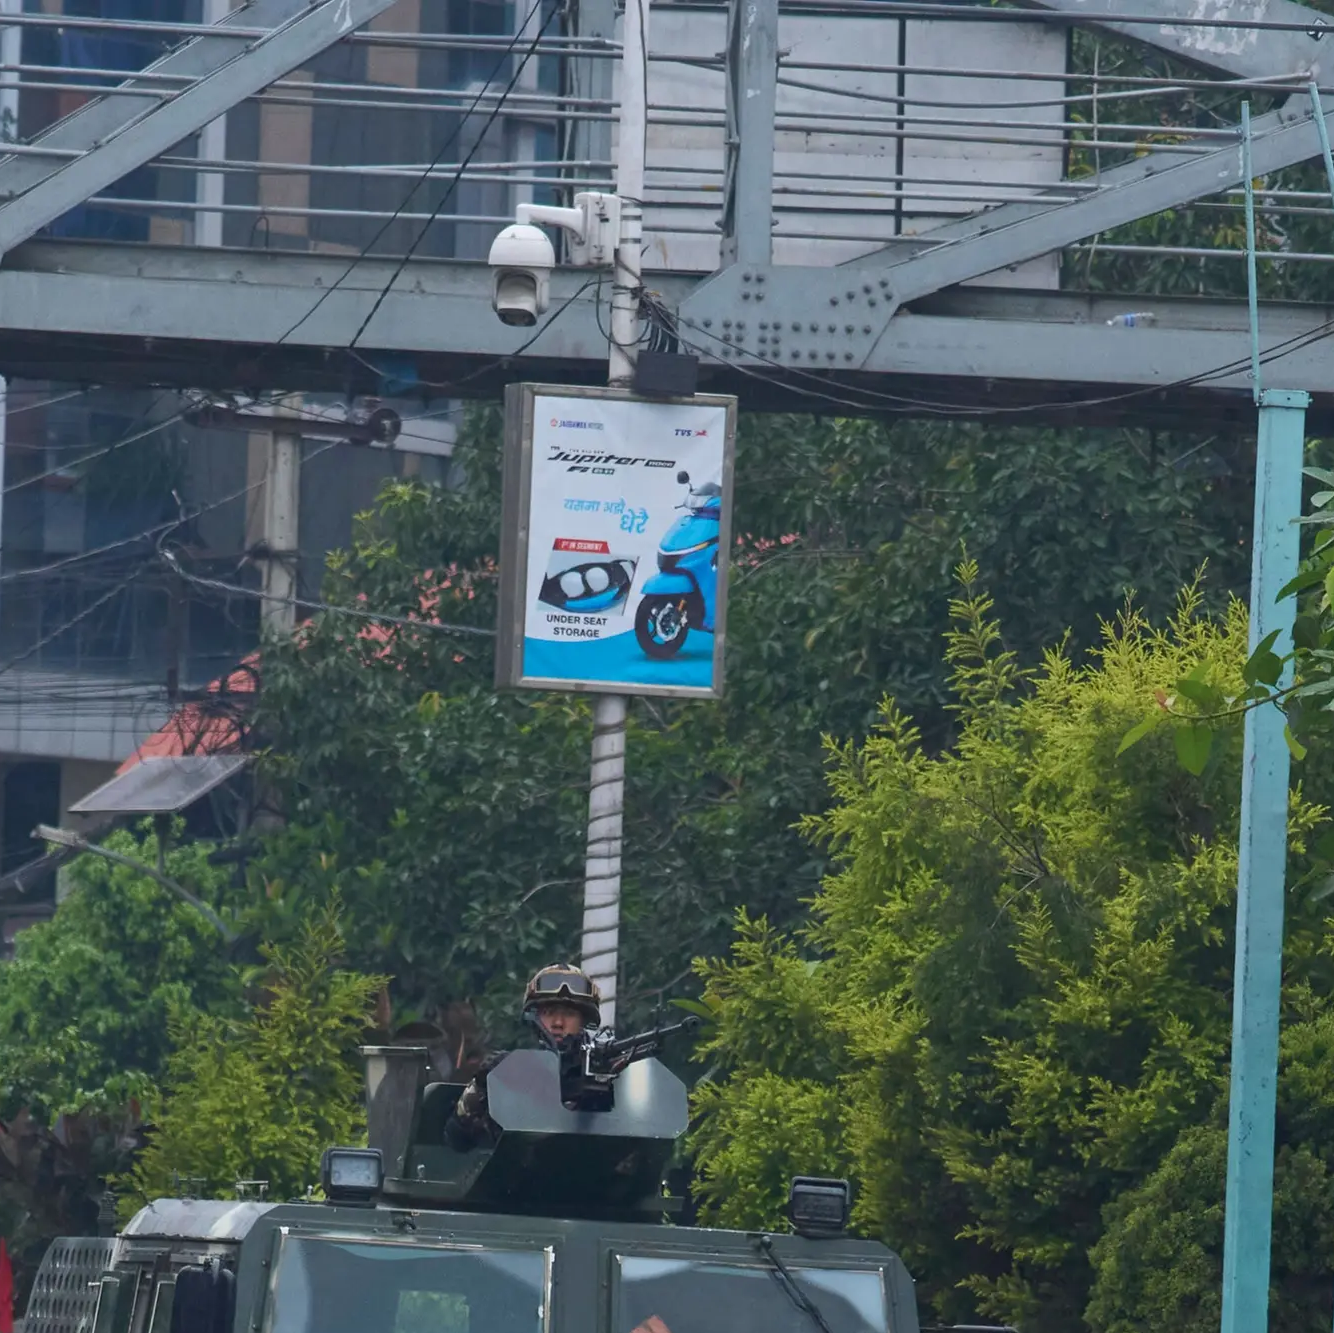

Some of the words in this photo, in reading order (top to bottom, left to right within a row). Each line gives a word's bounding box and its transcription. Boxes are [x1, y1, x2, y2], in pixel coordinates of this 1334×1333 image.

[675, 428, 692, 437] TVS
[547, 614, 581, 624] UNDER
[583, 616, 608, 626] SEAT
[553, 627, 600, 638] STORAGE
